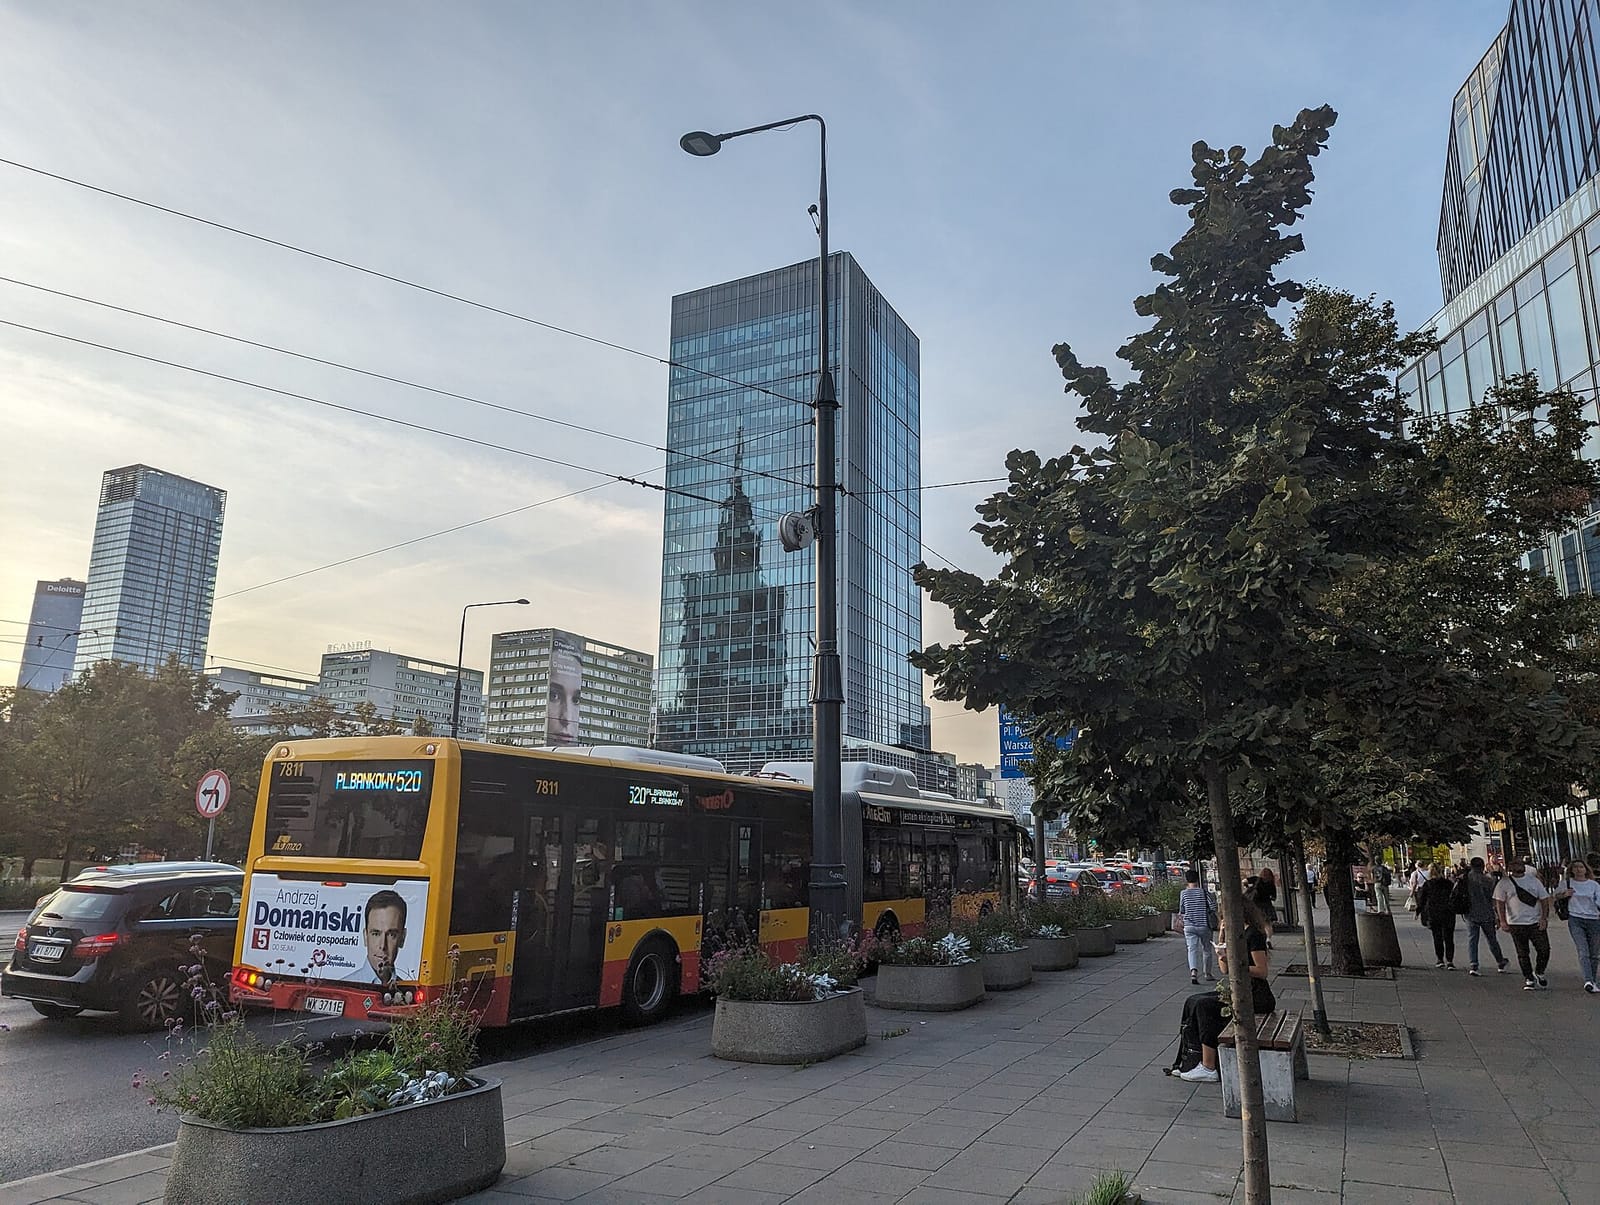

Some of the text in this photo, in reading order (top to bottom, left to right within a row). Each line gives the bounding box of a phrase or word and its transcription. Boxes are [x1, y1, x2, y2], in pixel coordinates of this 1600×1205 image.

[47, 584, 82, 594] Deloitte
[1003, 726, 1012, 736] Pl.
[1003, 741, 1033, 750] Warsza
[279, 762, 304, 777] 7811
[396, 770, 421, 792] 520
[535, 779, 559, 795] 7811
[629, 786, 647, 805] 520
[276, 888, 319, 909] Andrzej
[254, 901, 362, 933] Domański
[257, 931, 267, 949] 5
[273, 930, 360, 946] Człowiek od gospodarki
